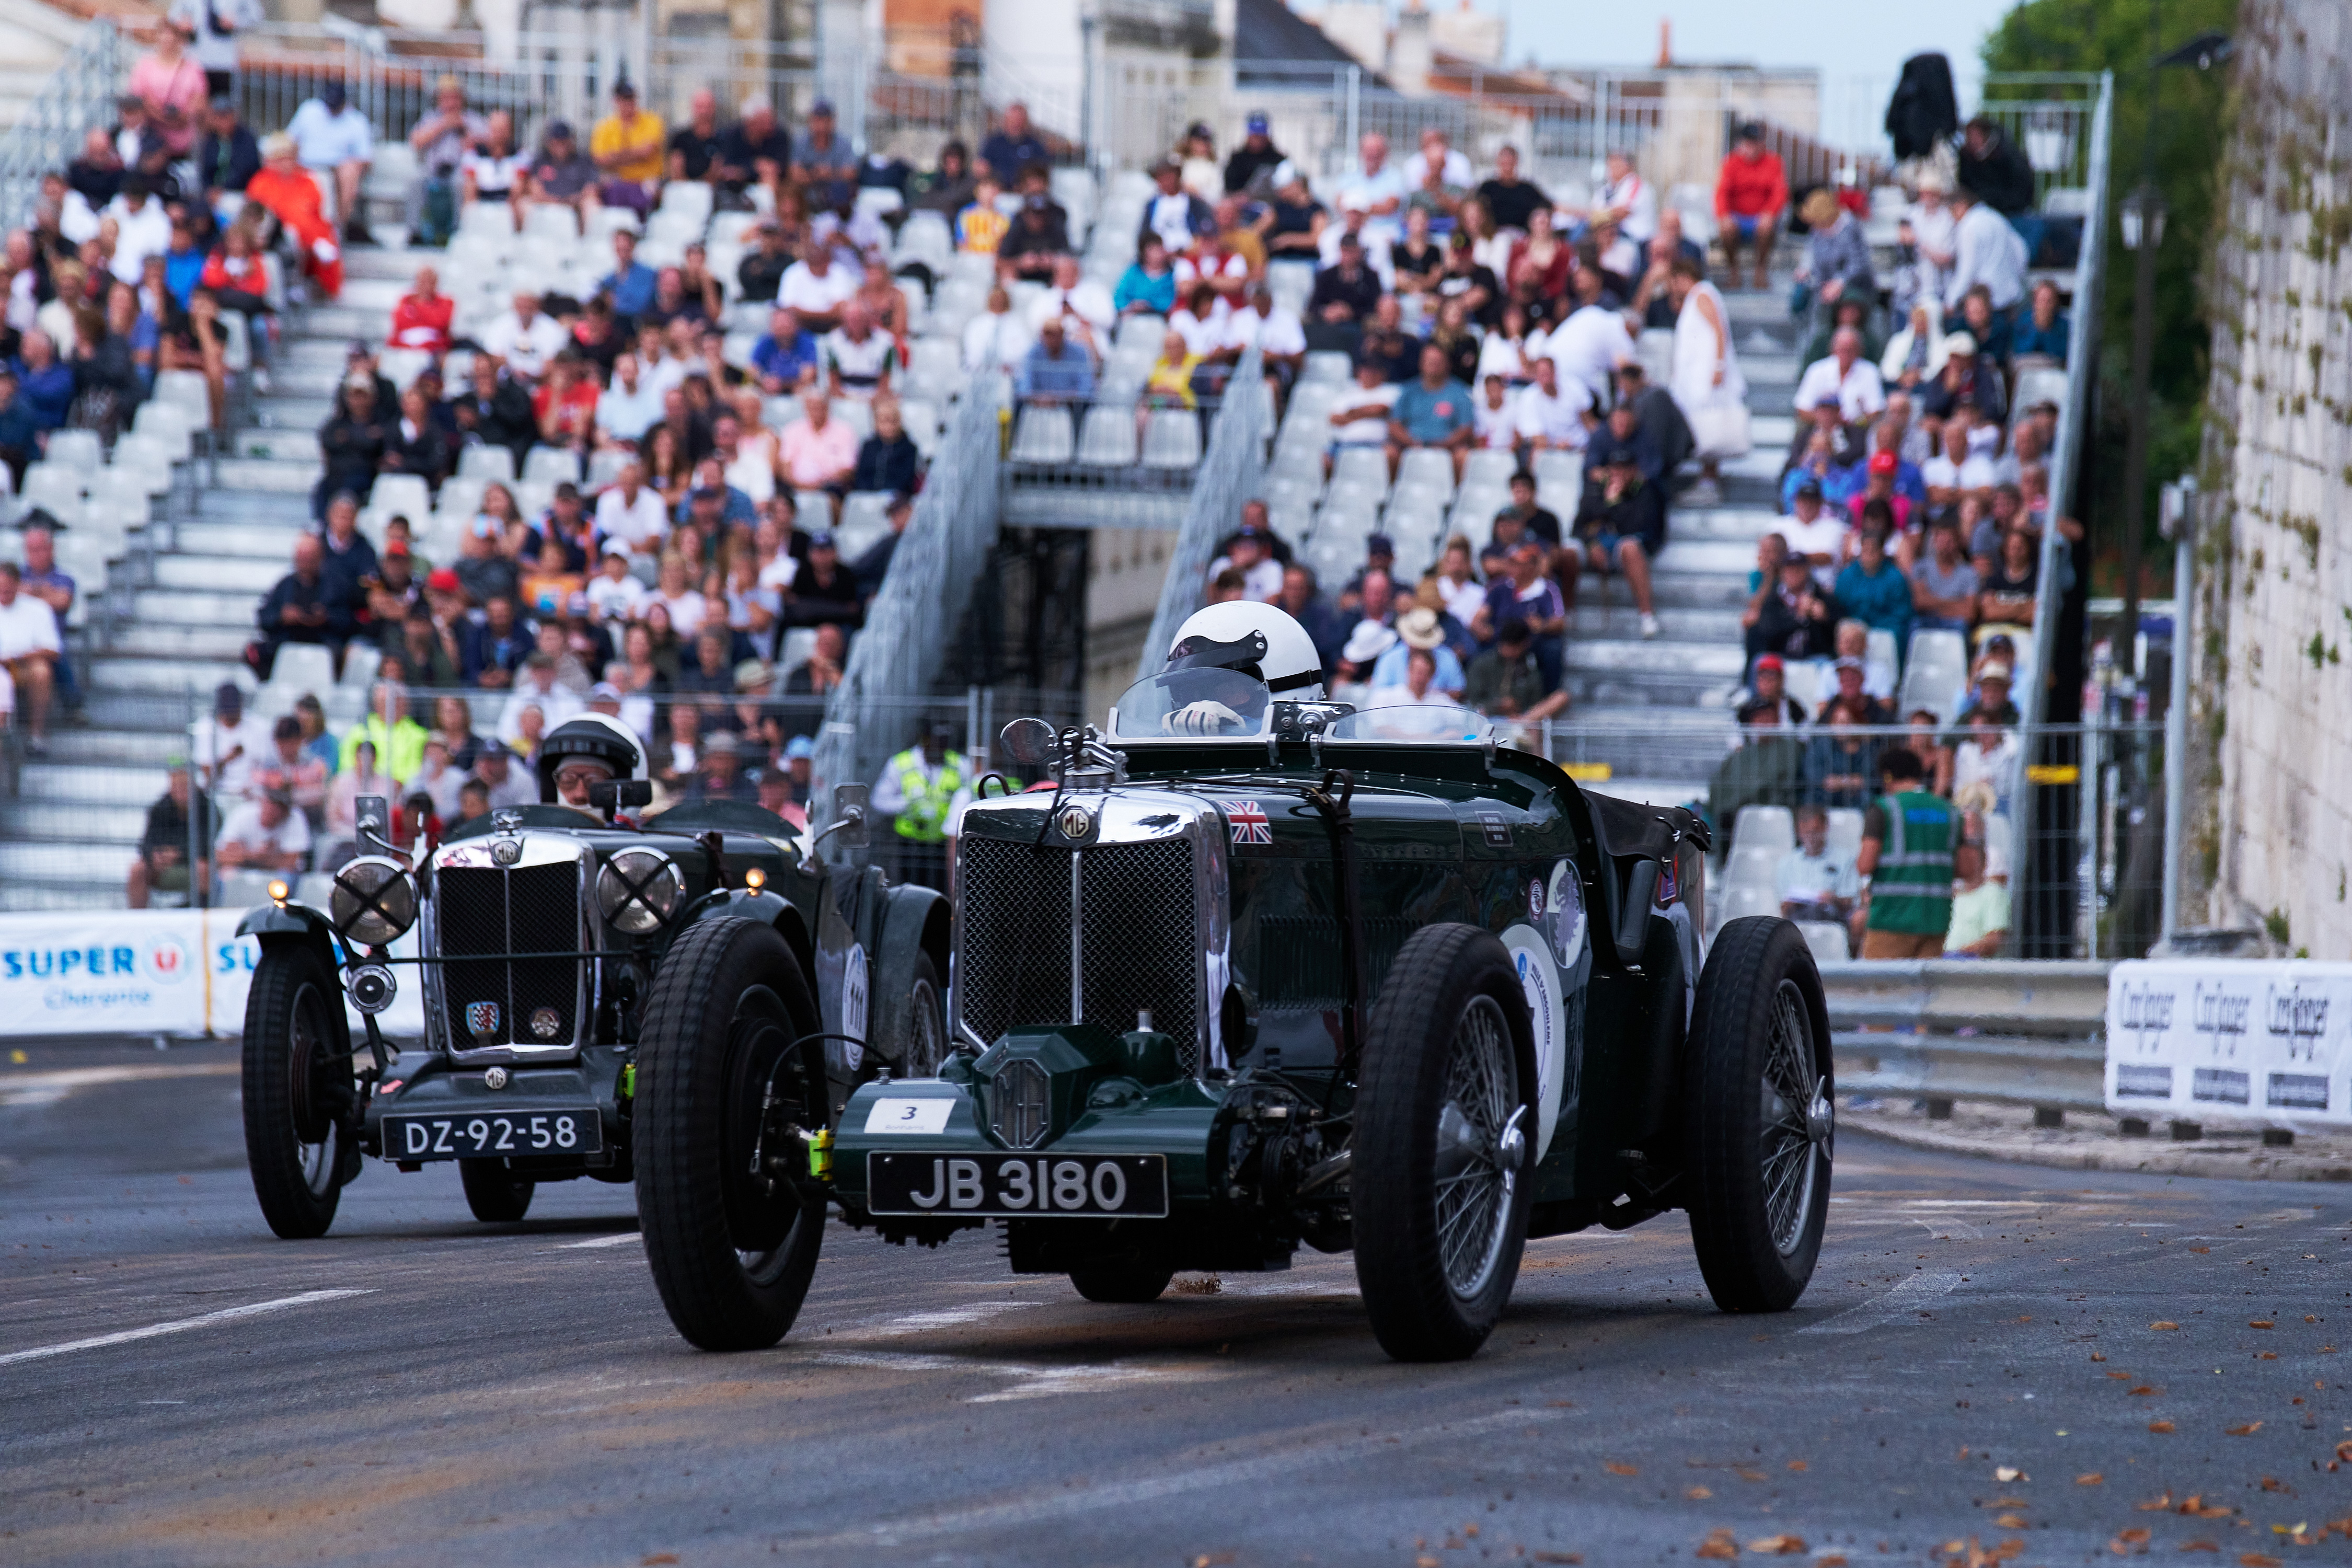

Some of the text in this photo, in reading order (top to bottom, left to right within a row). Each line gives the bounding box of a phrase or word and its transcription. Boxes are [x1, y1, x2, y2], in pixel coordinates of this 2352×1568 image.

[1065, 812, 1086, 835] MG
[496, 844, 515, 861] MG
[3, 946, 177, 978] SUPER U
[487, 1070, 506, 1088] MG
[901, 1106, 917, 1120] 3
[405, 1116, 577, 1154] DZ-92-58
[909, 1159, 1127, 1211] JB 3180
